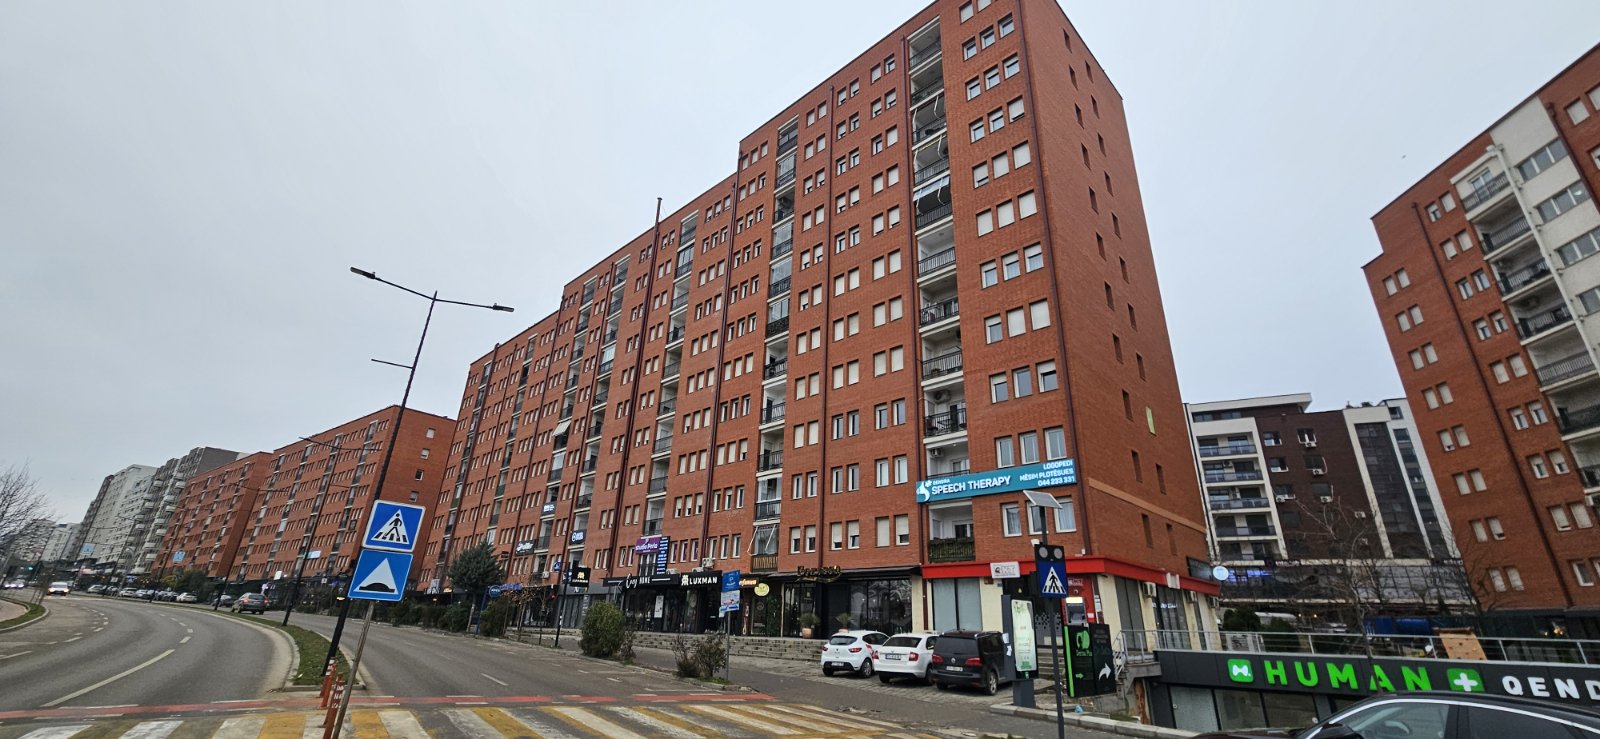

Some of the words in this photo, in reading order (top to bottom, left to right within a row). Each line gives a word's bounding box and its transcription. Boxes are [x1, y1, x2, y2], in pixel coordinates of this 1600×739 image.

[1043, 459, 1073, 470] LOGOPEDI
[1019, 472, 1039, 482] MËSIM
[931, 481, 966, 495] SPEECH
[968, 475, 1011, 490] THERAPY
[1037, 478, 1051, 487] 044
[689, 576, 718, 585] LUXMAN
[1263, 659, 1432, 692] HUMAN
